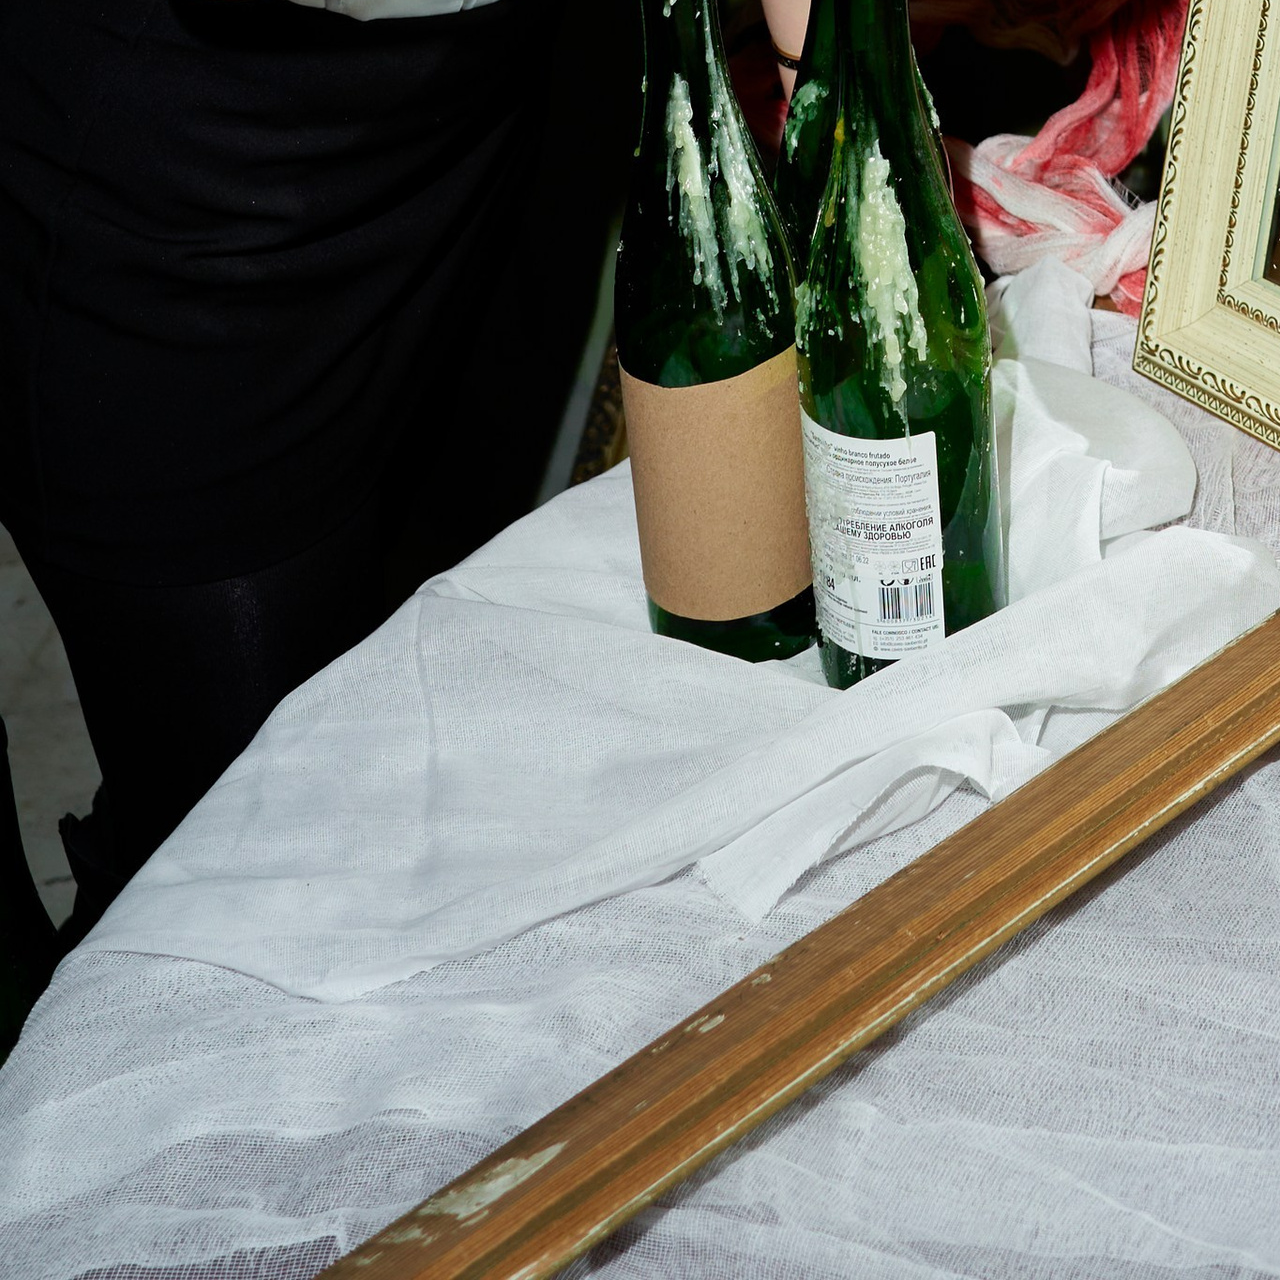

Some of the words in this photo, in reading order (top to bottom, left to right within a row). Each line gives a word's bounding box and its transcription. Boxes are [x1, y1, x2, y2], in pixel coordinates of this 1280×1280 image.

[848, 449, 868, 460] branco
[868, 451, 891, 460] frutado
[865, 459, 897, 469] полусухое
[895, 470, 931, 485] Португалия
[889, 516, 934, 533] АЛКОГОЛЯ
[834, 524, 862, 540] АШЕМУ
[864, 530, 912, 542] ЗДОРОВЬЮ
